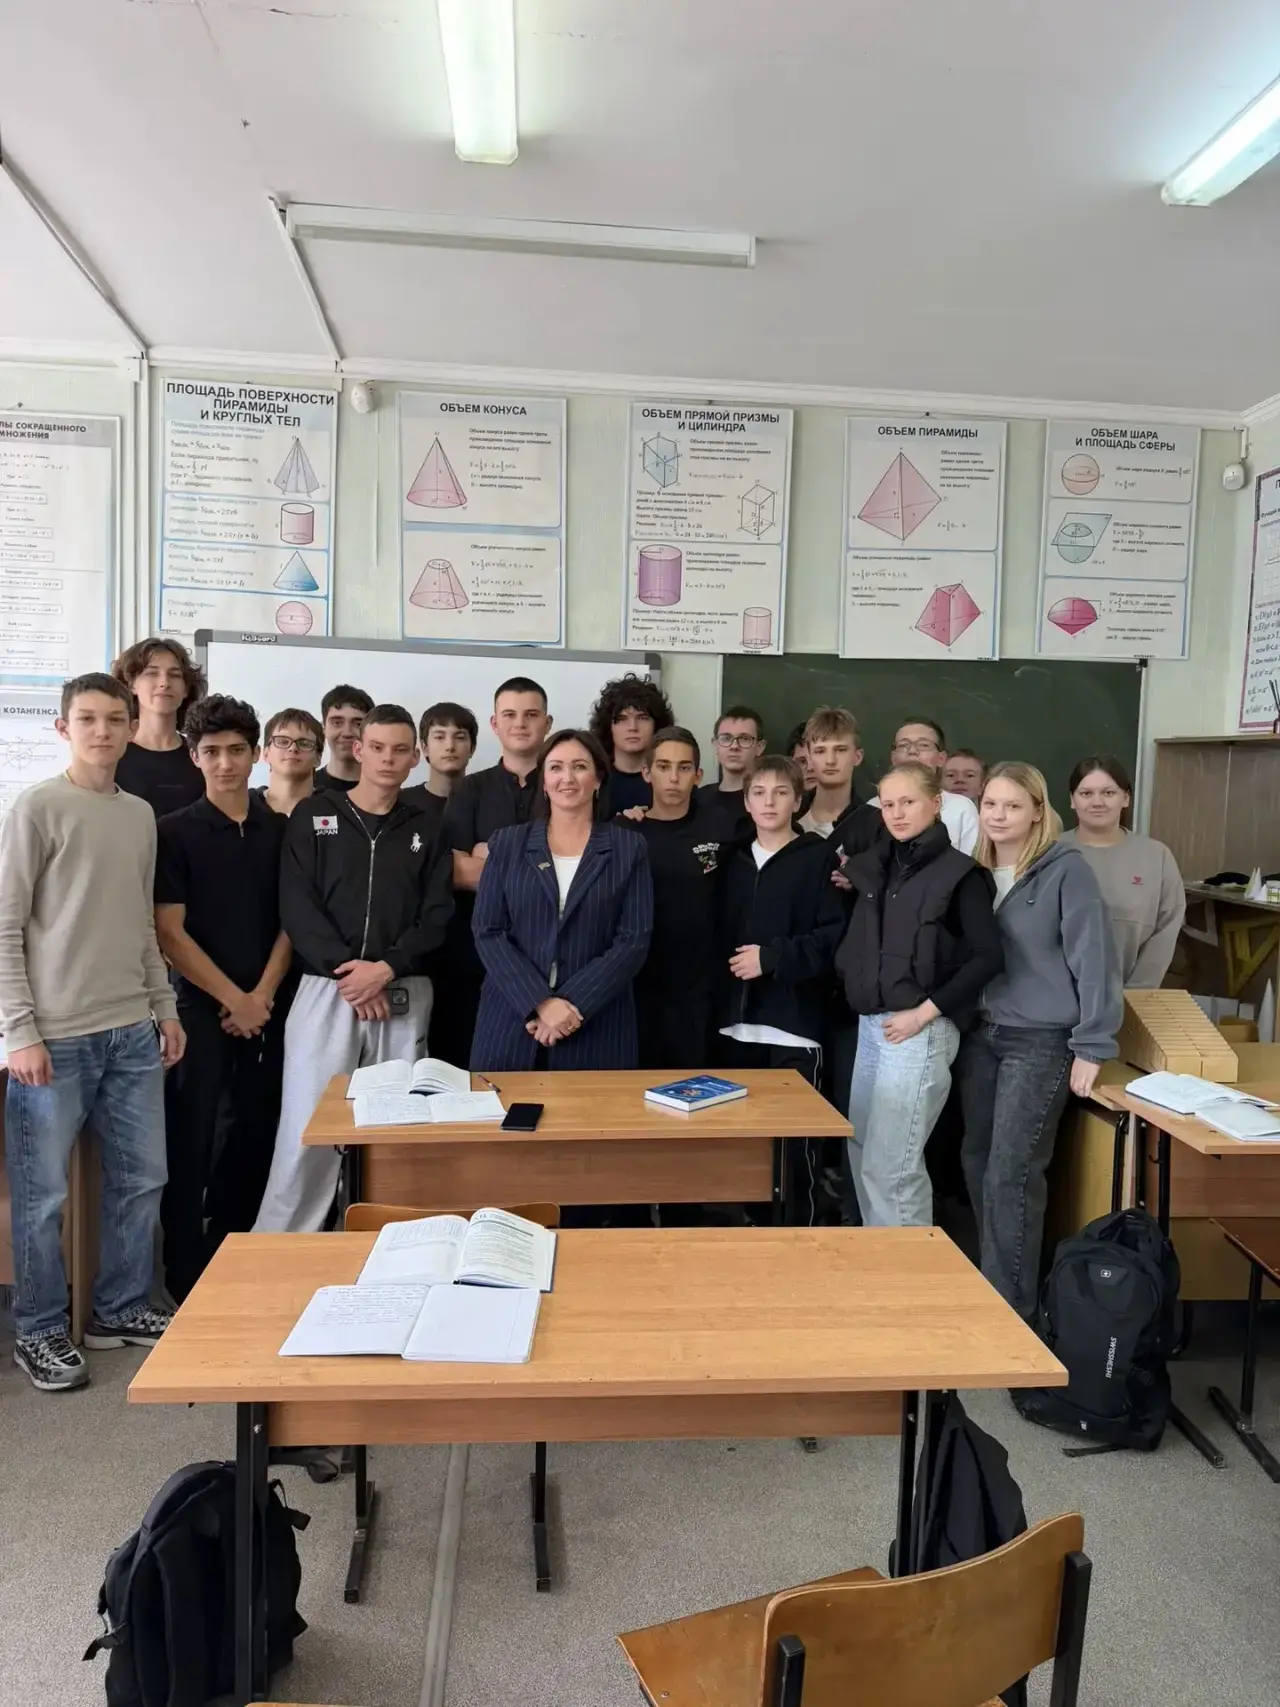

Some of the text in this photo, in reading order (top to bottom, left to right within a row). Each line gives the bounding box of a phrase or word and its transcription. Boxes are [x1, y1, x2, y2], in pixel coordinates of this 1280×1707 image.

[167, 383, 335, 405] ПЛОЩАДЬ ПОВЕРХНОСТИ
[213, 399, 288, 414] ПИРАМИДЫ
[440, 403, 527, 415] ОБЪЕМ КОНУСА
[200, 410, 301, 427] И КРУГЛЫХ ТЕЛ
[642, 409, 780, 423] ОБЪЕМ ПРЯМОЙ ПРИЗМЫ
[16, 422, 87, 433] СОКРАЩЕННОГО
[678, 421, 746, 433] И ЦИЛИНДРА
[877, 426, 978, 438] ОБЪЕМ ПИРАМИДЫ
[1091, 428, 1159, 440] ОБЪЕМ ШАРА
[1075, 437, 1176, 451] И ПЛОЩАДЬ СФЕРЫ
[3, 706, 59, 716] КОТАНГЕНСА
